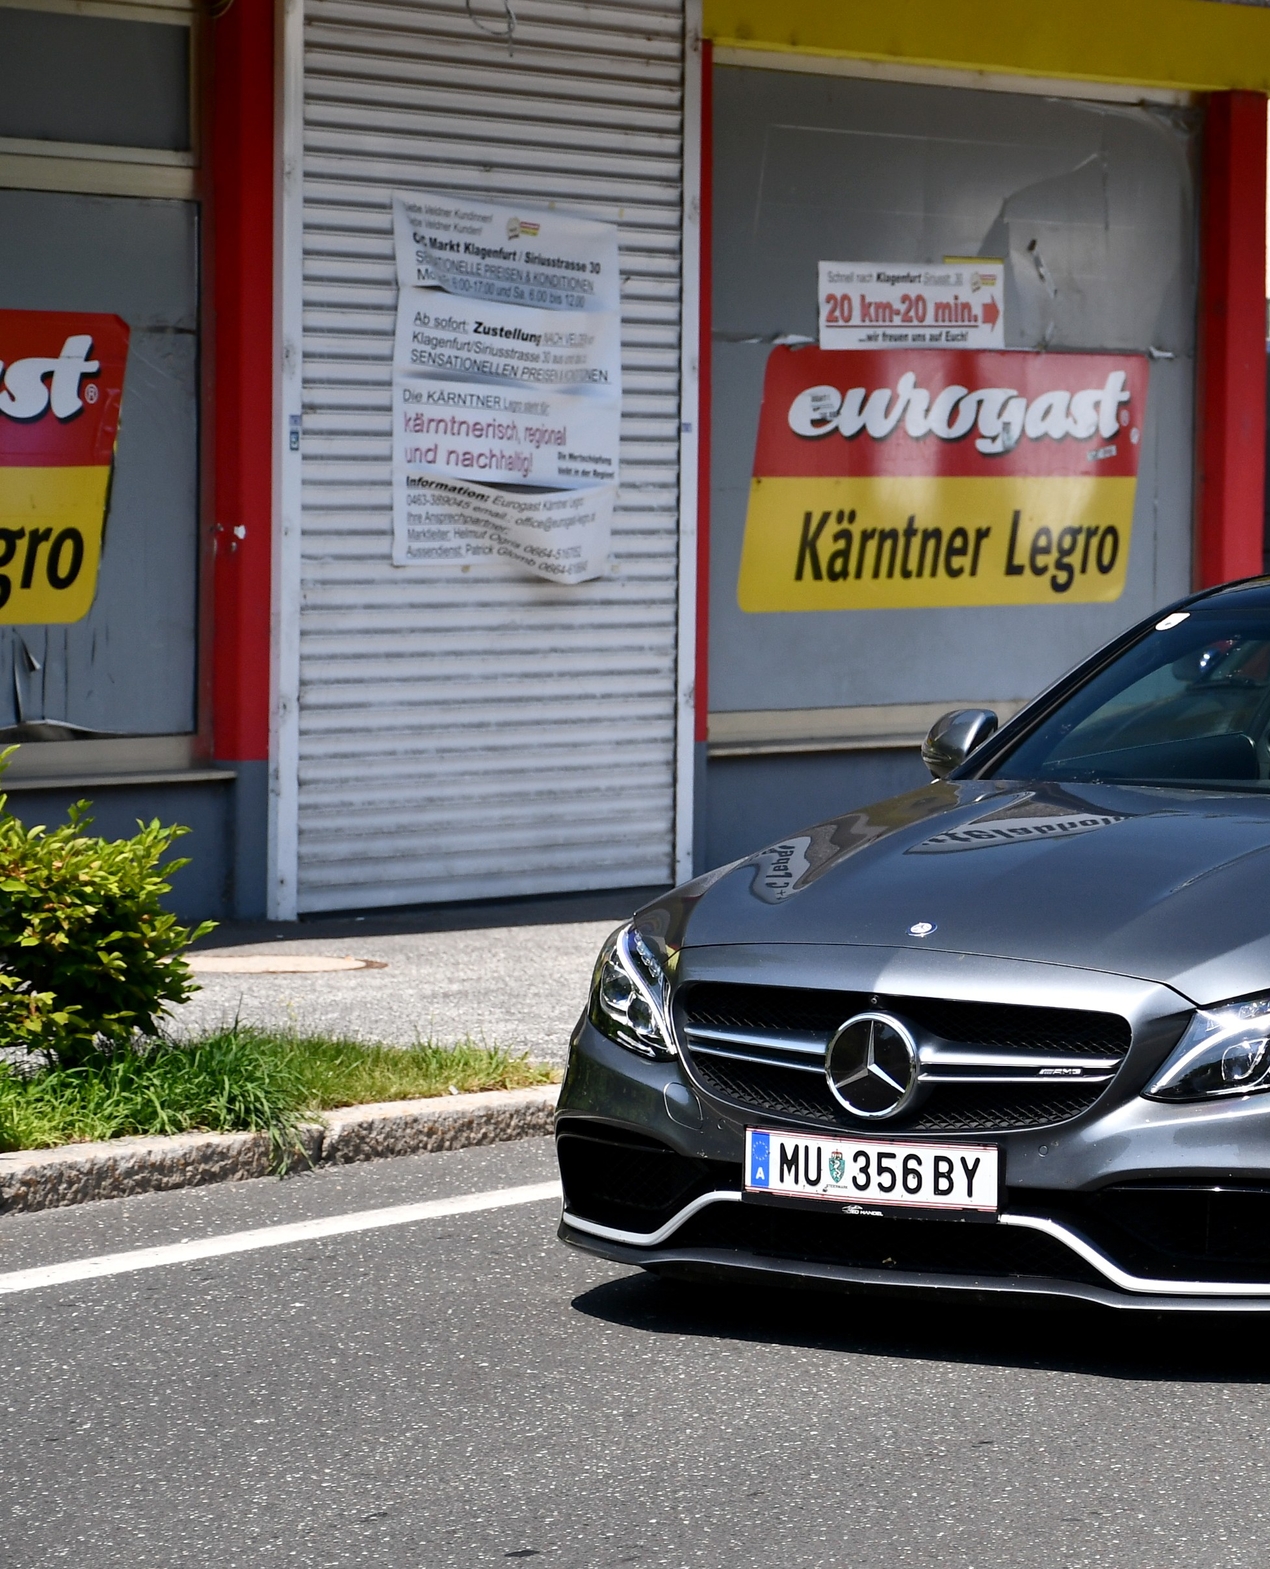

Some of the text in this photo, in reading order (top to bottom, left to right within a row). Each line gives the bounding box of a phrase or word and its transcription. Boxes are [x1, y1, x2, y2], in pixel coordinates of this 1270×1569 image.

[429, 236, 461, 254] Markt
[464, 241, 518, 262] Klagenfurt
[524, 251, 588, 273] Siriusstrasse
[589, 261, 602, 275] 30
[876, 271, 922, 286] Klagenfurt
[413, 311, 431, 326] Ab
[825, 293, 853, 323] 20
[934, 294, 979, 323] min.
[882, 331, 909, 343] freuen
[912, 333, 926, 343] uns
[928, 331, 943, 343] auf
[945, 331, 968, 343] Euch!
[0, 334, 100, 421] st
[411, 348, 519, 378] SENSATIONELLEN
[402, 388, 424, 404] Die
[427, 389, 502, 409] KÄRNTNER
[787, 370, 1131, 453] eurogast
[404, 410, 567, 449] kärntnerisch, regional
[404, 443, 533, 478] und nachhaltig!
[406, 476, 490, 503] Information:
[793, 508, 1120, 593] Kärntner Legro
[755, 1166, 766, 1180] A
[779, 1142, 822, 1187] MU
